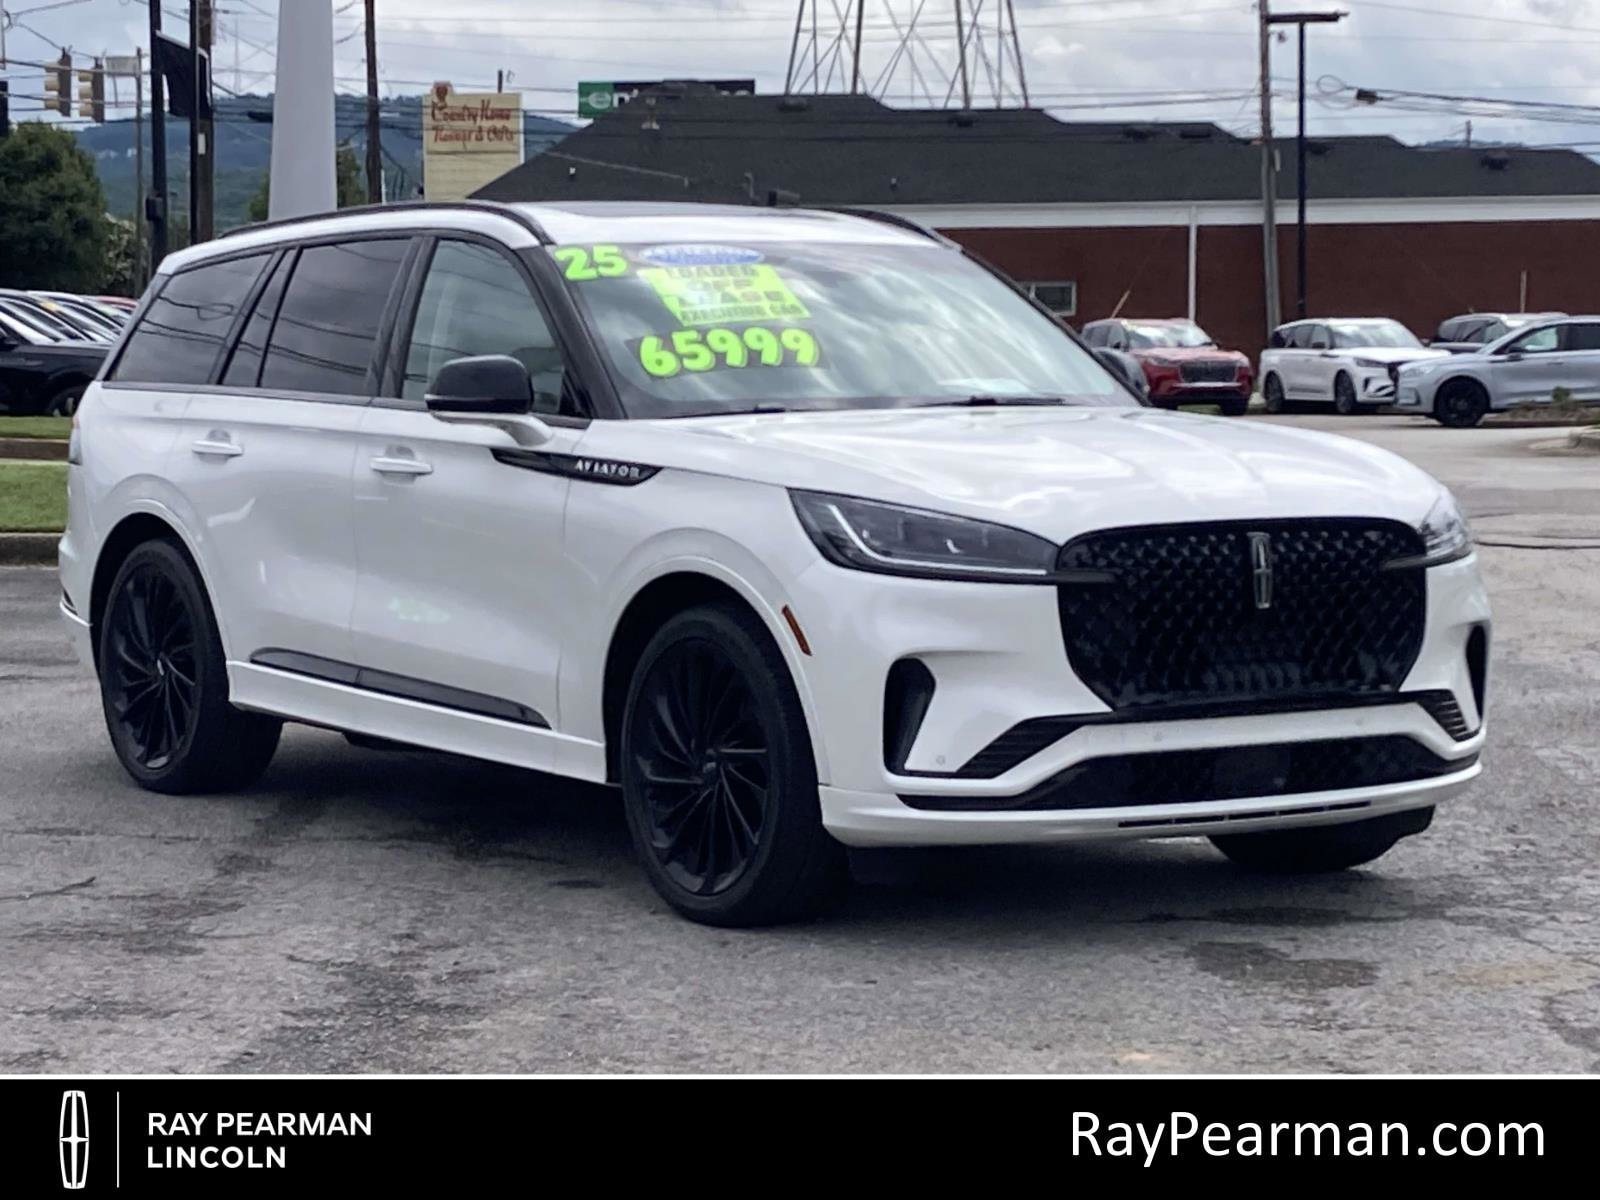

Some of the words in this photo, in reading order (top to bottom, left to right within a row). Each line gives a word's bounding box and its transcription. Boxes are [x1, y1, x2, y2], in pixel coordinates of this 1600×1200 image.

[554, 244, 628, 281] 25
[639, 326, 820, 378] 65999
[575, 458, 641, 478] AVIATOR
